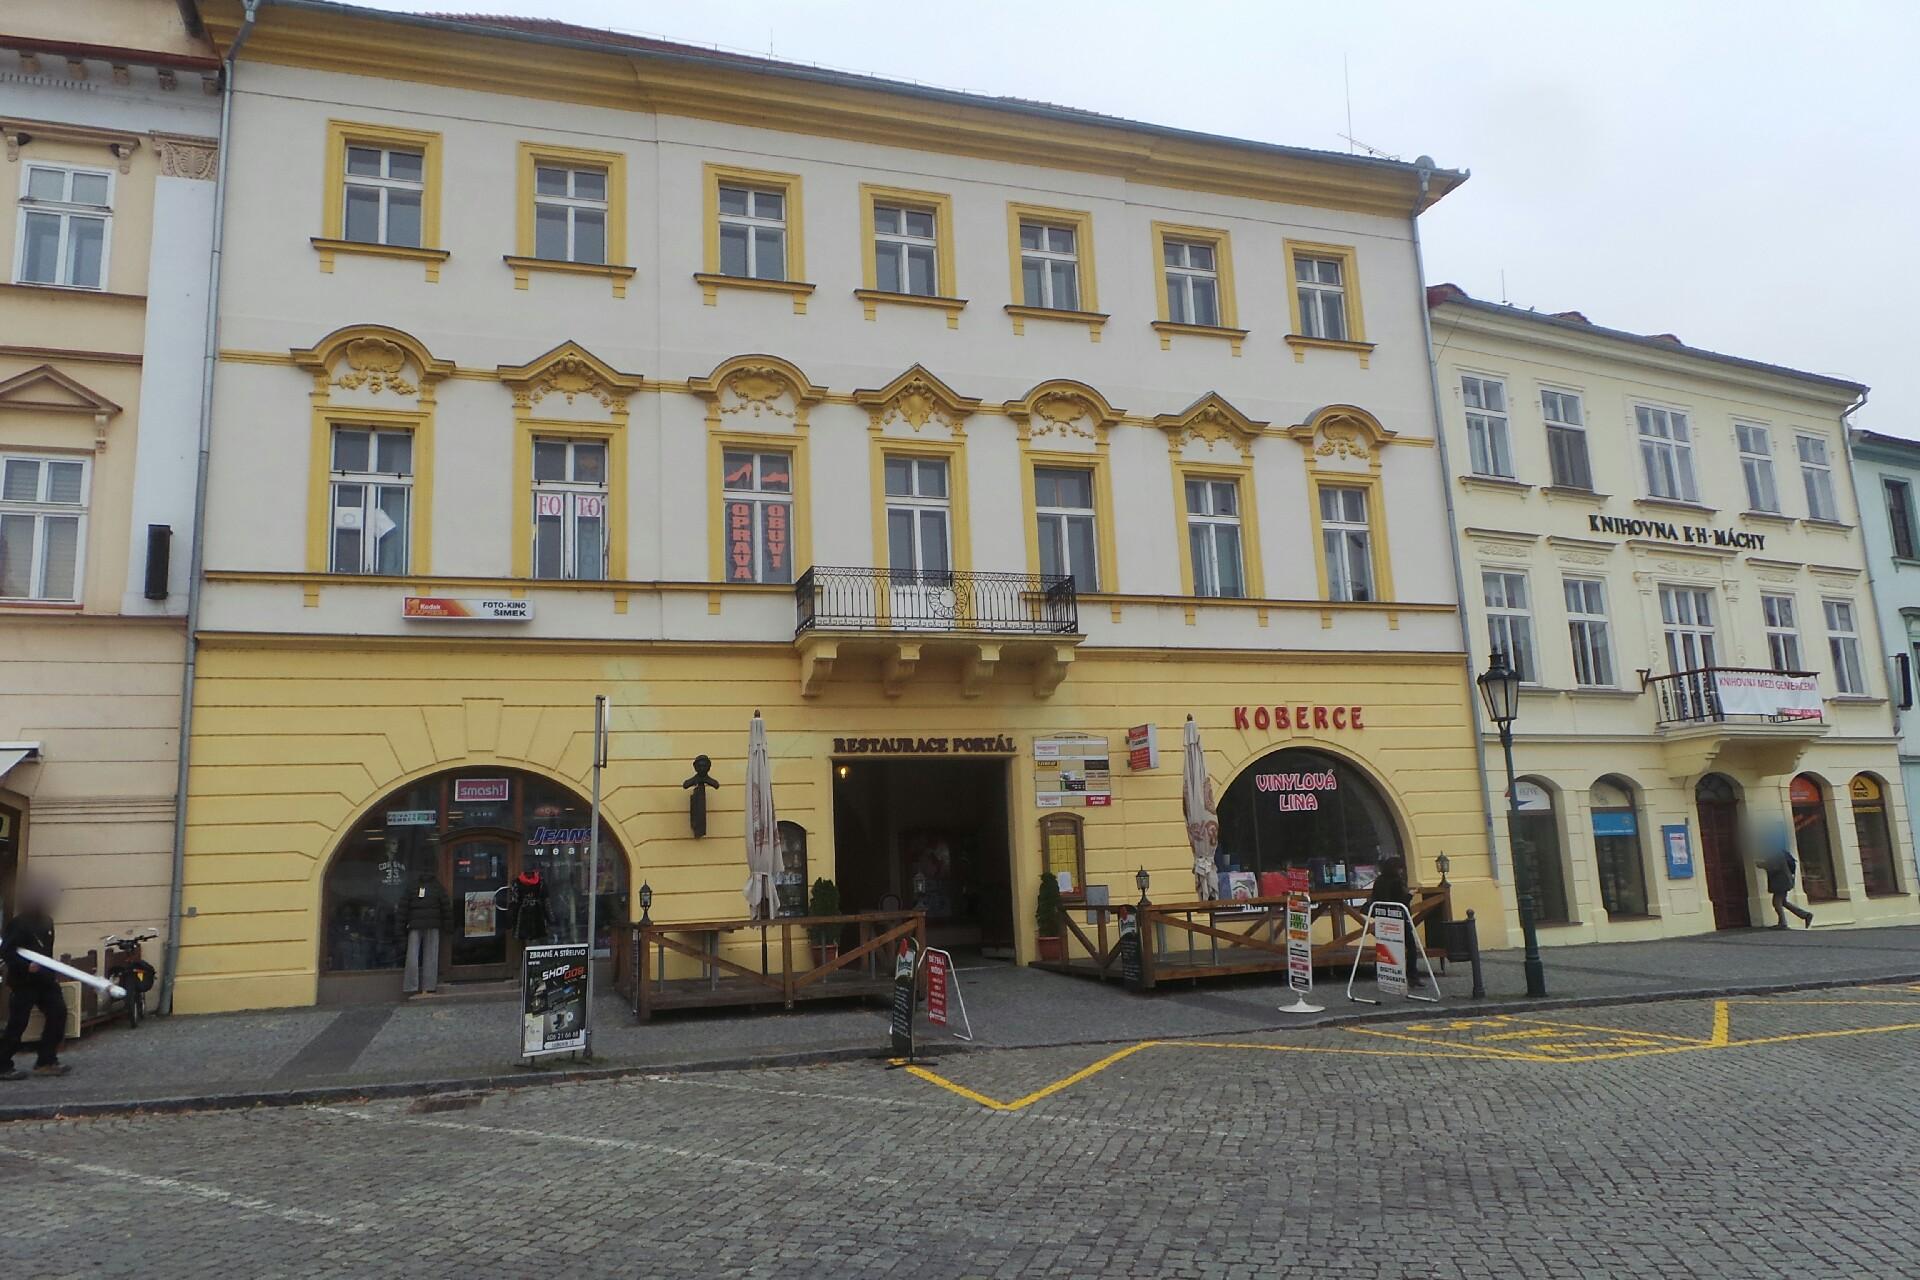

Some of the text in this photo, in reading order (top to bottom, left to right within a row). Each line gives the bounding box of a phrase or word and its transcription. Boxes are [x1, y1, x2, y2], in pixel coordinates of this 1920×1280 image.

[537, 495, 601, 516] FO TO
[1588, 514, 1679, 540] KNIHOVNA
[731, 503, 752, 579] OPRAVA
[482, 601, 527, 609] FOTO-KINO
[493, 608, 527, 617] ŠIMEK
[1234, 706, 1364, 730] KOBERCE
[833, 734, 1017, 753] RESTAURACE PORTÁL
[1255, 769, 1337, 792] VINYLOVÁ
[460, 785, 503, 796] smash!
[1279, 793, 1318, 811] LINA
[534, 847, 590, 856] wear
[529, 951, 553, 959] ZBRANĚ
[553, 950, 558, 958] A
[542, 964, 570, 981] SHOP
